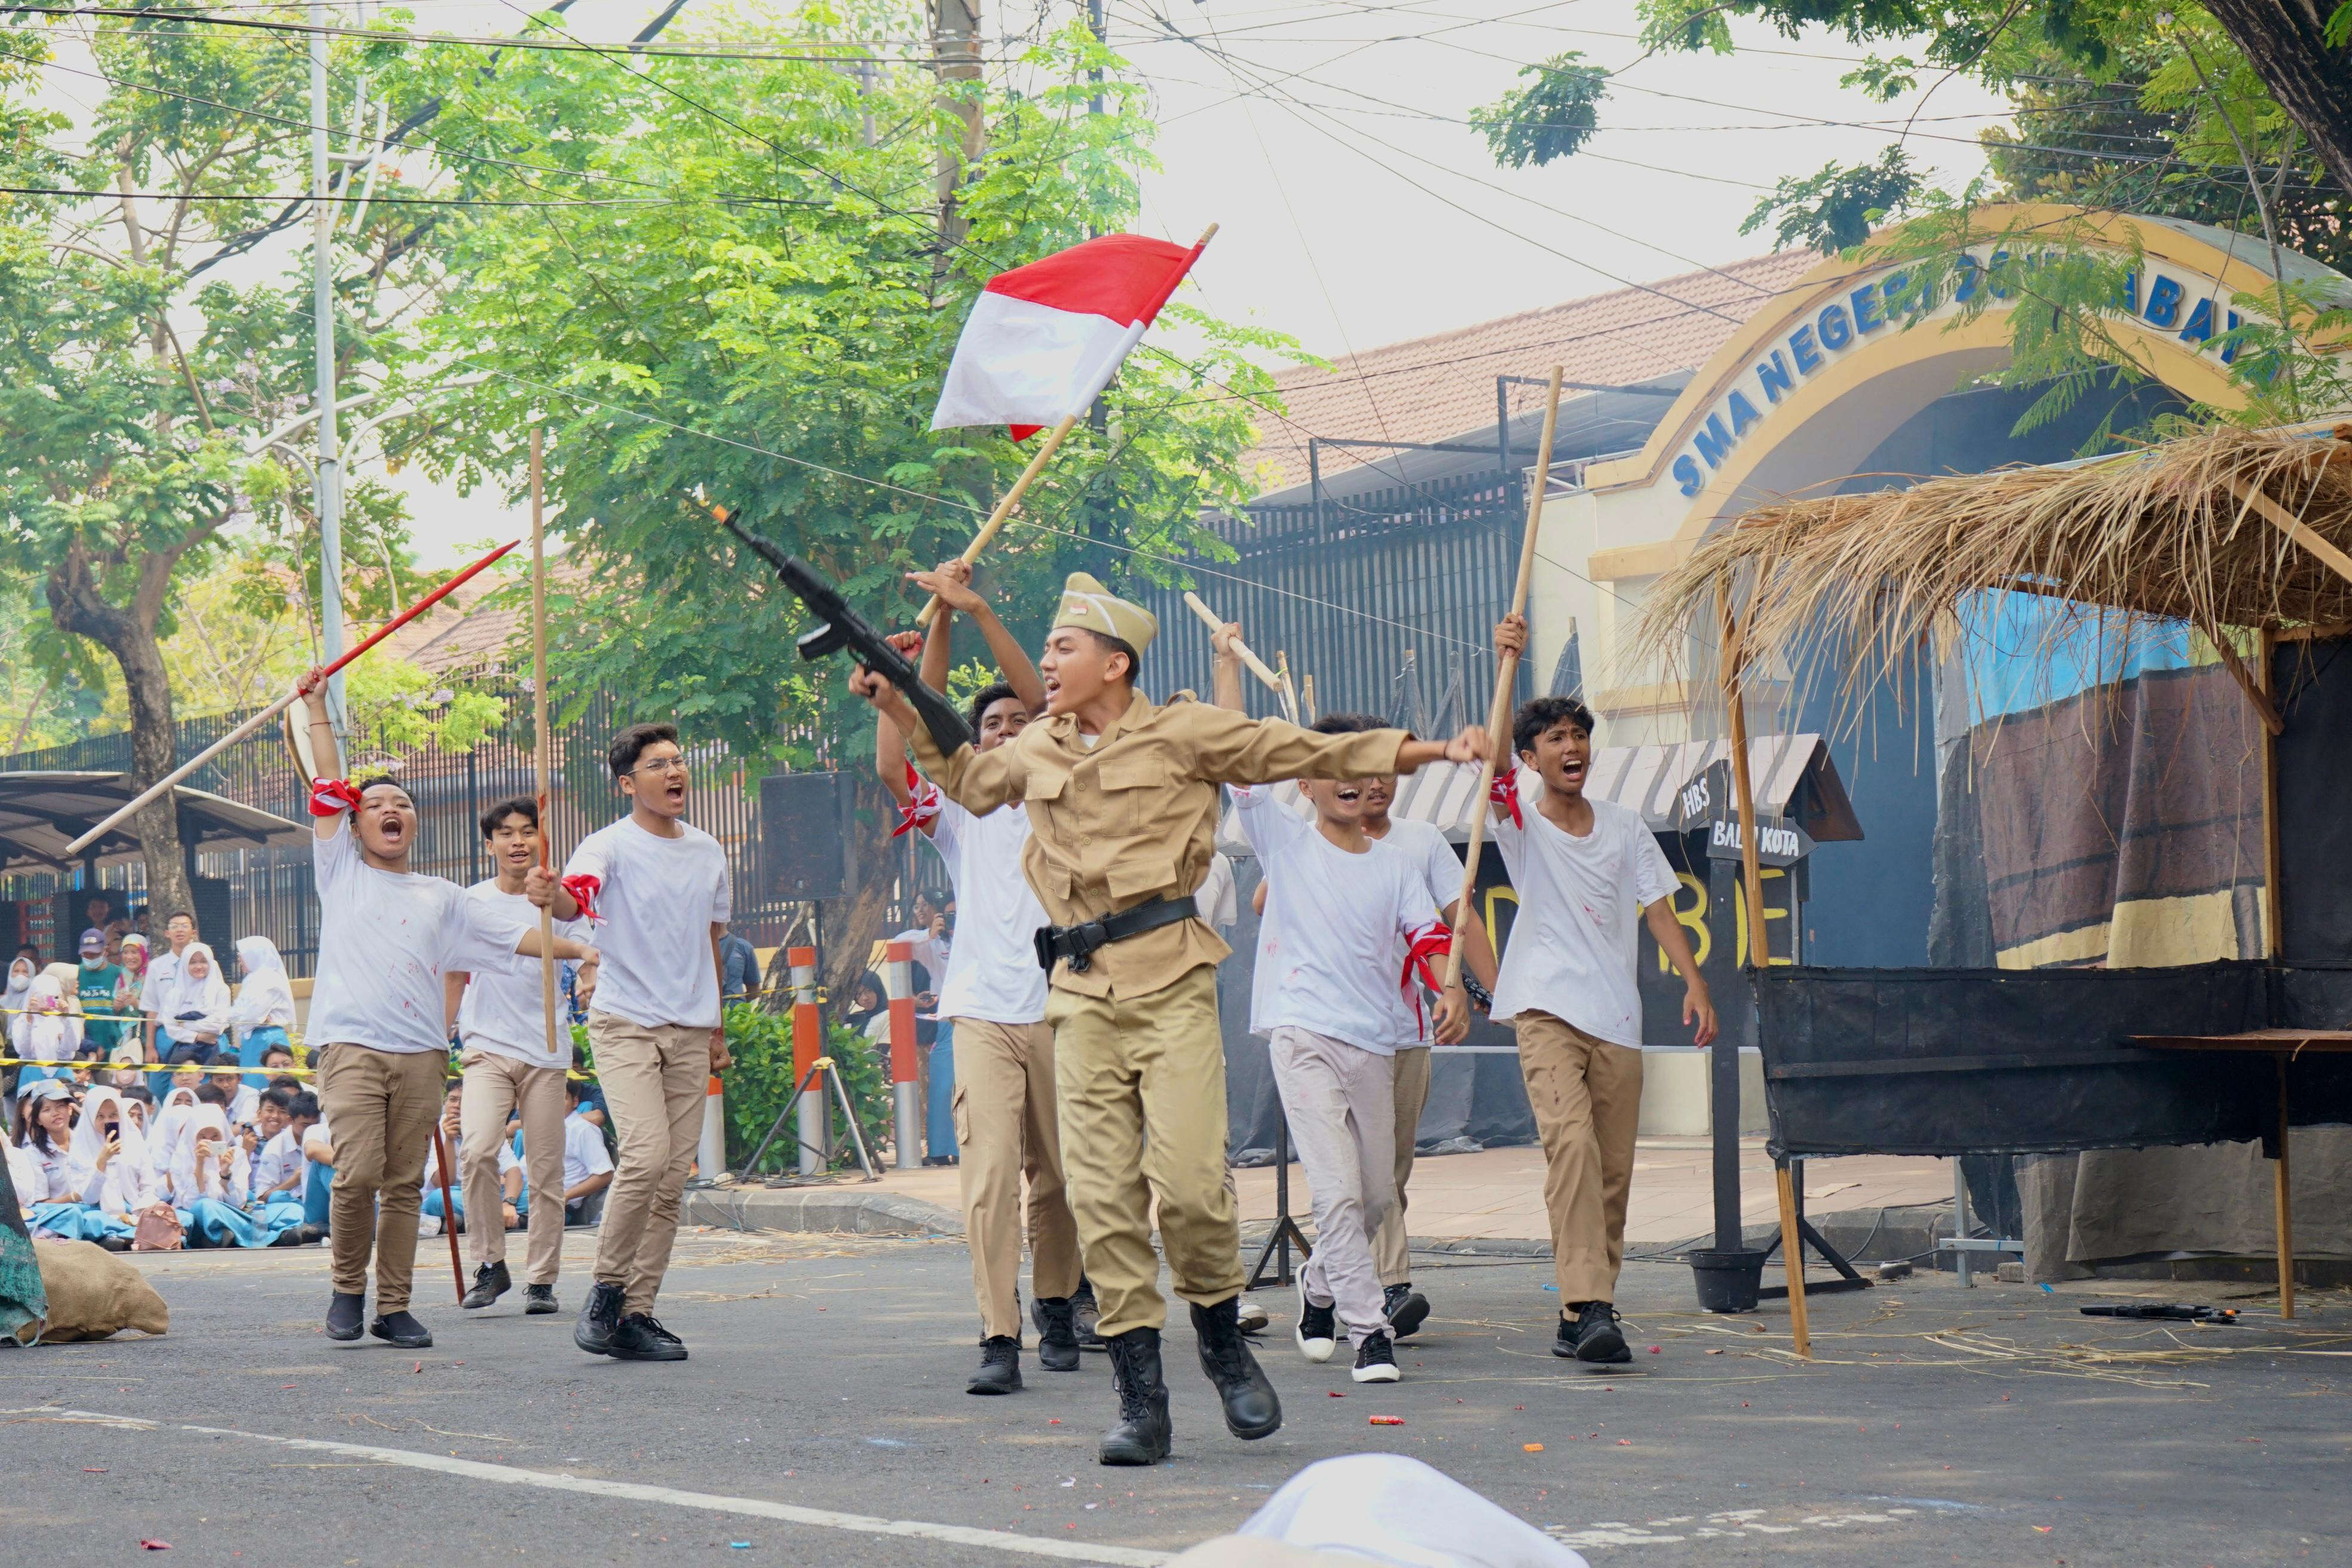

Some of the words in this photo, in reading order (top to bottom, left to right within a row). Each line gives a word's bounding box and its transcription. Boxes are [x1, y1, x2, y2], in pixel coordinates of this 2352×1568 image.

[1673, 388, 1760, 497] SMA
[1755, 271, 1933, 404] NEGERI
[1682, 777, 1710, 819] HBS
[1713, 820, 1759, 849] BALI
[1760, 826, 1799, 856] KOTA
